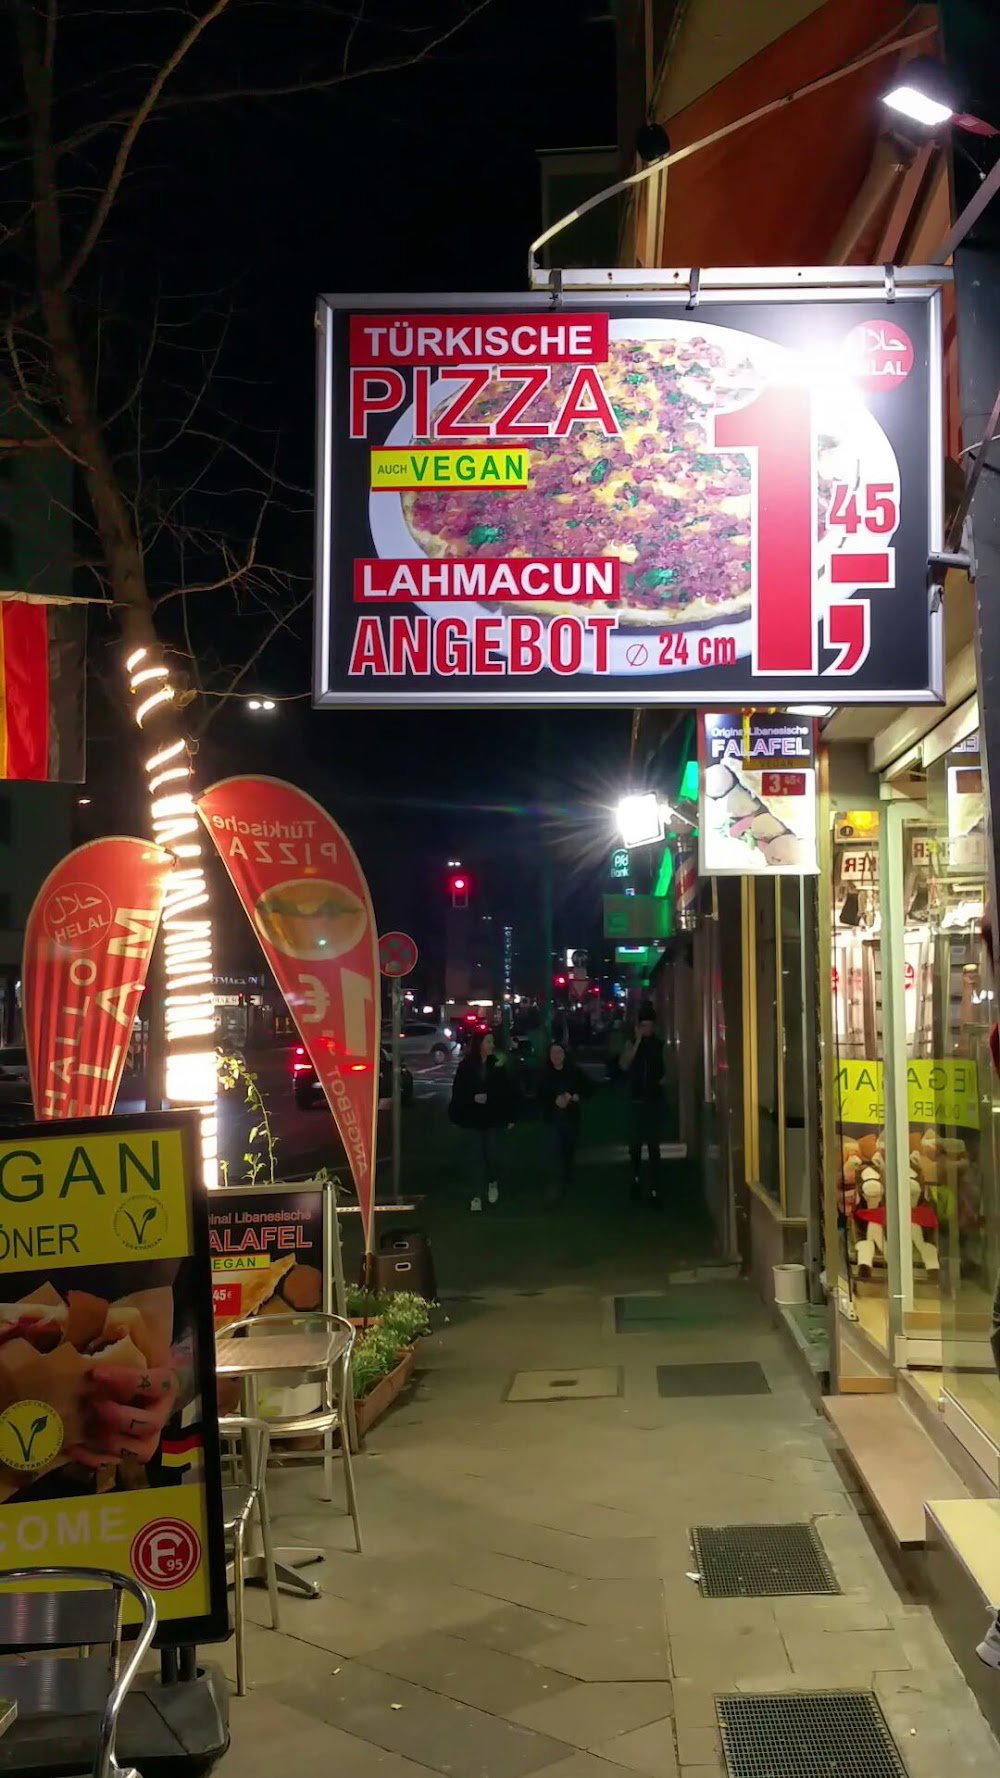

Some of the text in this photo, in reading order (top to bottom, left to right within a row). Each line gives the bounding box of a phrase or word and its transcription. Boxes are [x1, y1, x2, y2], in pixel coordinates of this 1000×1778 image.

[363, 321, 593, 357] TÜRKISCHE
[349, 364, 622, 440] PIZZA
[377, 454, 523, 481] AUCH VEGAN
[363, 562, 613, 598] LAHMACUN
[347, 614, 620, 676] ANGEBOT
[658, 631, 689, 666] 24
[697, 634, 737, 666] cm
[711, 736, 810, 758] FALAFEL
[54, 913, 110, 944] HELAL
[42, 957, 97, 1120] HALLO
